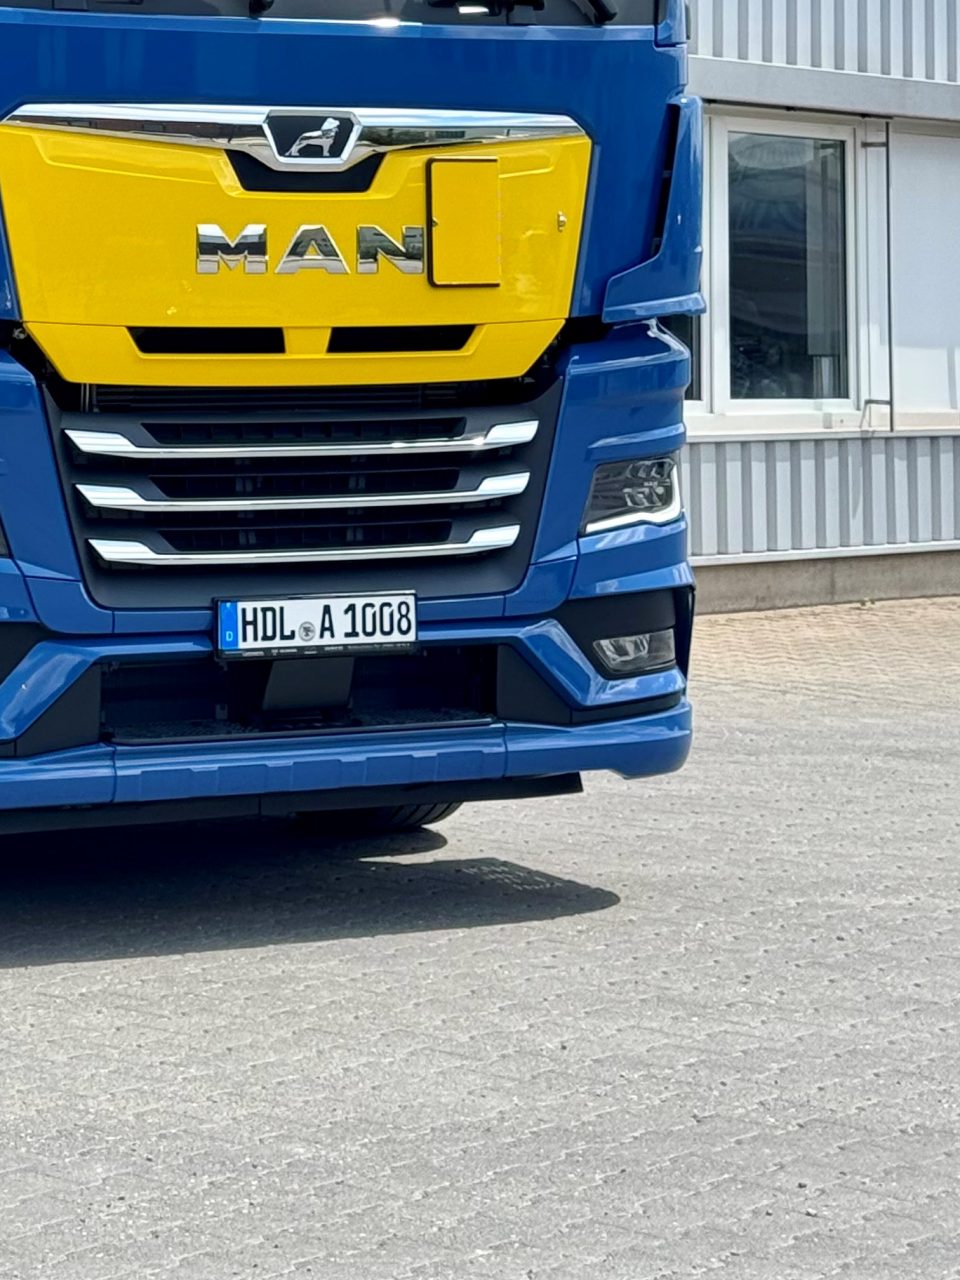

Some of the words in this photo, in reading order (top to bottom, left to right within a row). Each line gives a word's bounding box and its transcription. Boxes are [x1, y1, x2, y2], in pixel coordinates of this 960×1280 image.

[196, 223, 425, 274] MAN
[226, 631, 233, 641] D
[241, 606, 296, 643] HDL
[319, 604, 335, 639] A
[343, 600, 412, 639] 1008
